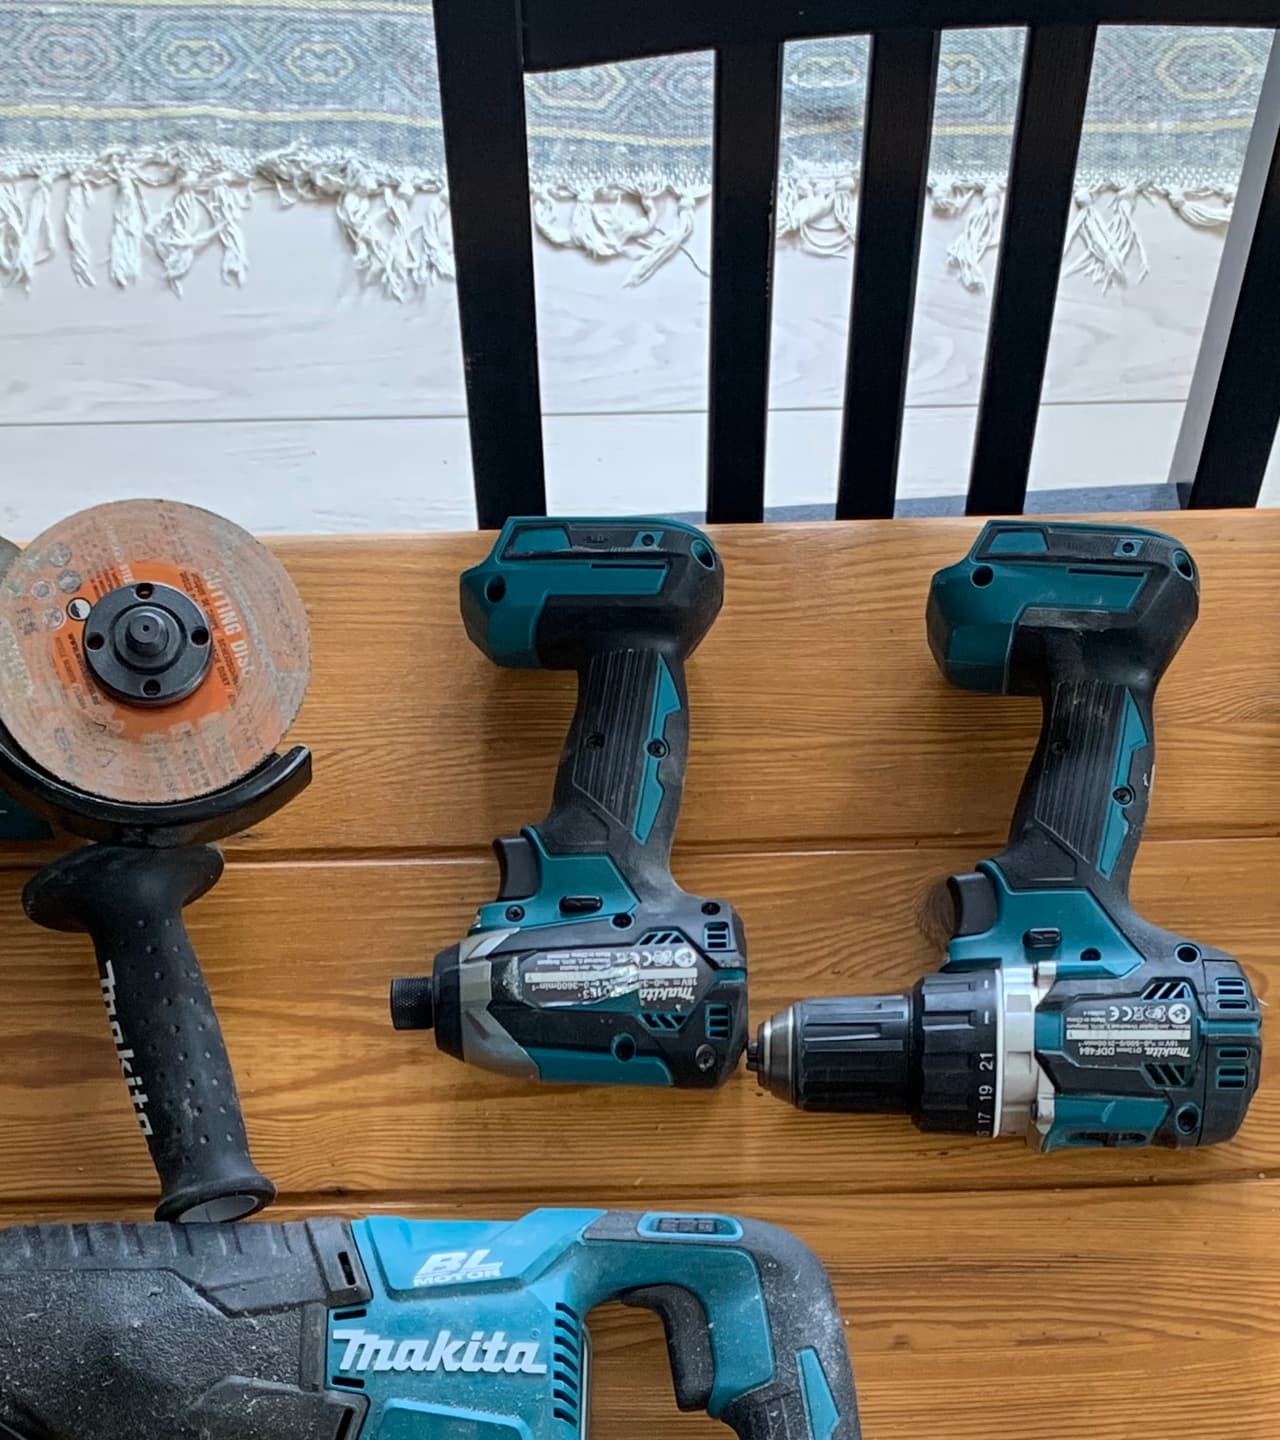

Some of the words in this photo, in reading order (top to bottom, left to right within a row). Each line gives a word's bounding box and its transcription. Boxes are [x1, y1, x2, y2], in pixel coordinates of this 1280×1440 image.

[978, 1052, 993, 1070] 21
[978, 1084, 992, 1100] 19
[977, 1111, 991, 1123] 17
[416, 1248, 503, 1274] BL
[412, 1270, 503, 1287] MOTOR
